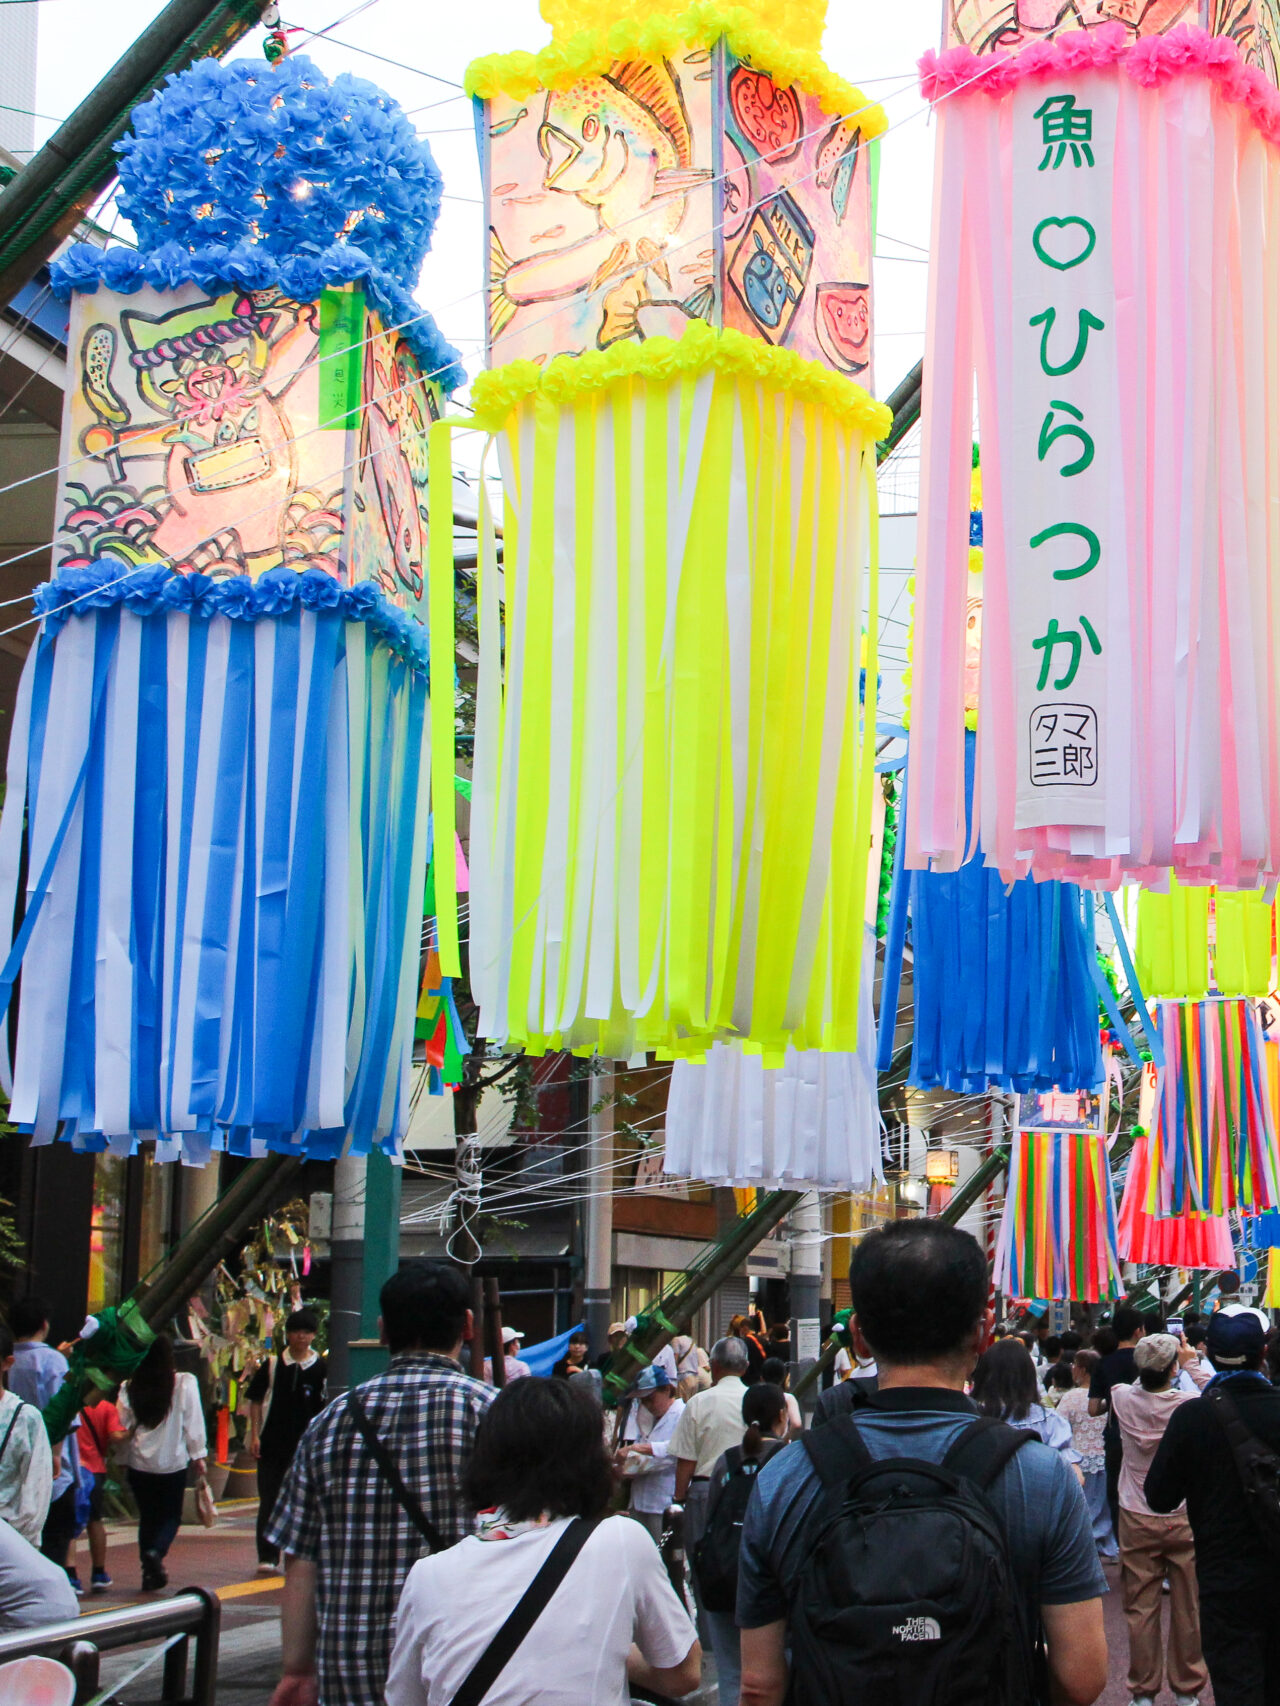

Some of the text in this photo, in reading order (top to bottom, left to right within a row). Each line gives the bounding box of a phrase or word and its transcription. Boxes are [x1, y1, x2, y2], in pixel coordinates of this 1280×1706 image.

[770, 204, 804, 264] MILK
[1035, 713, 1090, 743] タマ
[1033, 743, 1094, 779] 三郎
[892, 1624, 925, 1635] NORTH
[906, 1616, 925, 1627] THE
[901, 1632, 925, 1642] FACE
